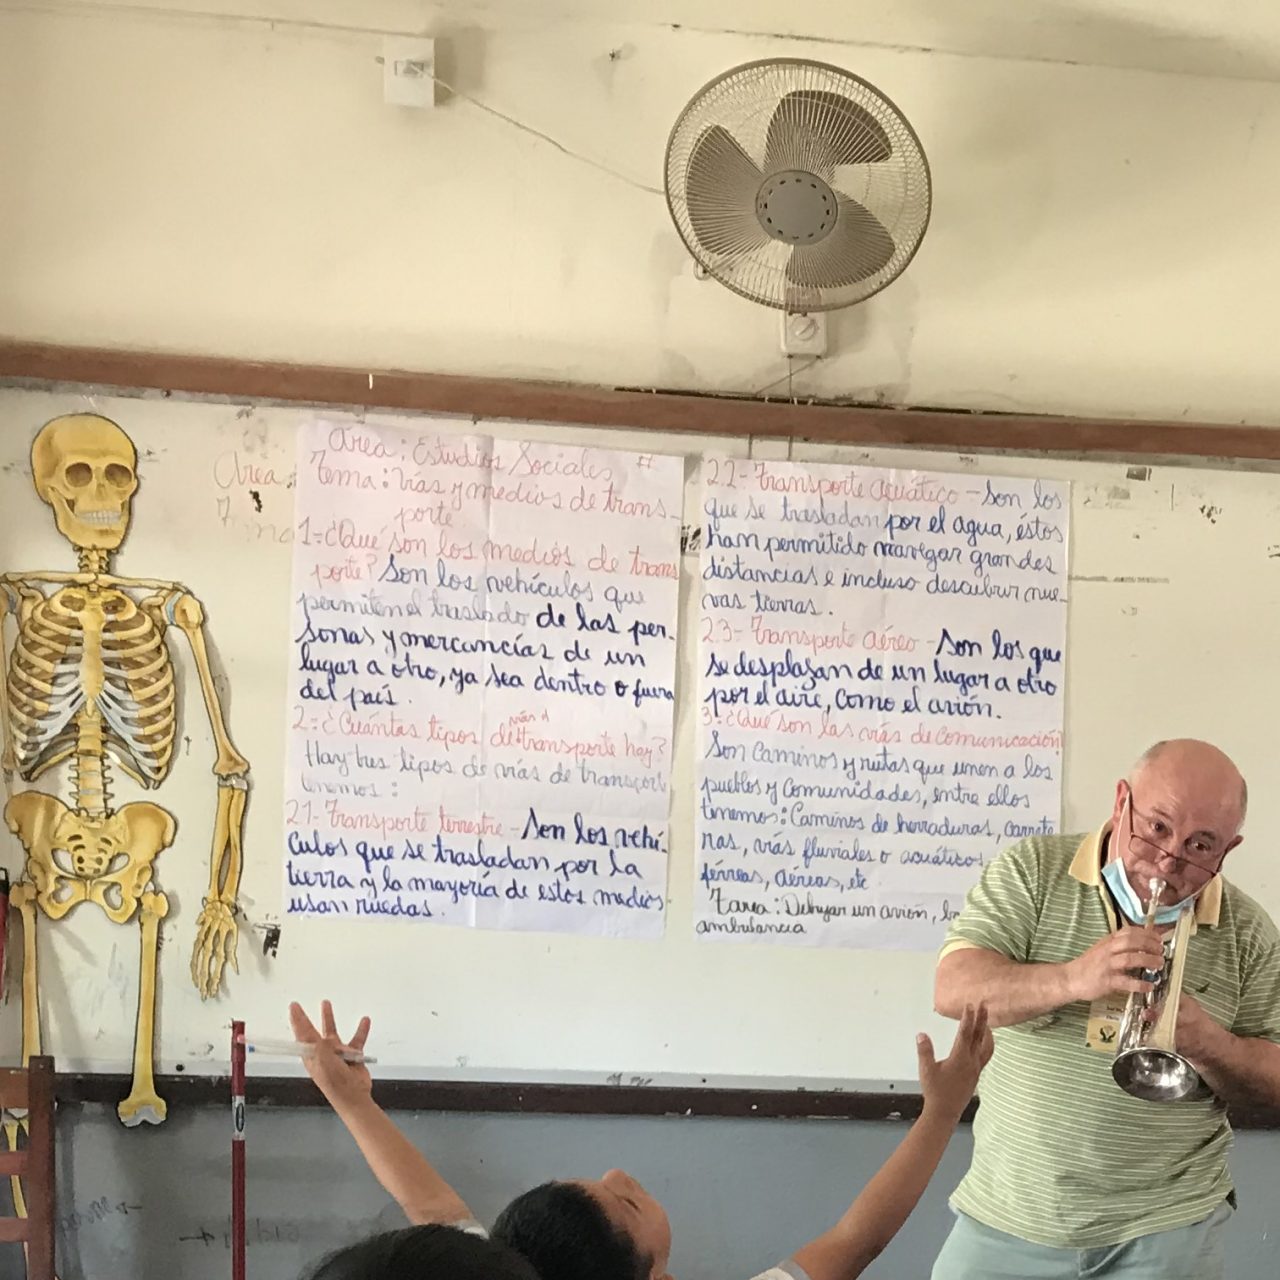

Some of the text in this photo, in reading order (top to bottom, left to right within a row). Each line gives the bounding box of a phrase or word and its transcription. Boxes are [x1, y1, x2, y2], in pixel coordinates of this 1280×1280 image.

[509, 441, 614, 482] Sociales
[451, 482, 464, 511] y
[466, 481, 562, 511] medios
[570, 484, 598, 513] de
[754, 462, 1062, 509] Transporte acuático los
[395, 501, 453, 533] porte
[704, 497, 738, 531] que
[744, 496, 766, 521] se
[780, 496, 880, 528] trasladan
[884, 513, 921, 540] por
[927, 505, 946, 535] el
[1015, 512, 1064, 543] éstos
[438, 523, 477, 560] los
[483, 537, 575, 568] medios
[588, 544, 619, 574] de
[706, 523, 760, 551] han
[763, 530, 868, 562] permitido
[969, 548, 1058, 578] grandes
[437, 558, 477, 593] los
[486, 567, 594, 602] vehículos
[604, 586, 646, 614] que
[702, 554, 1020, 599] distancias e incluso descubrir
[536, 602, 566, 629] de
[575, 602, 621, 635] las
[702, 593, 747, 611] vas
[382, 629, 398, 659] y
[401, 632, 554, 661] mercancías
[563, 640, 592, 663] de
[604, 649, 646, 669] un
[751, 615, 1062, 675] Transporte aéreo los que
[299, 641, 360, 684] lugar
[366, 658, 385, 676] a
[449, 667, 479, 695] ya
[484, 662, 525, 689] sea
[533, 665, 607, 697] dentro
[615, 680, 629, 698] o
[632, 678, 675, 707] fuera
[299, 678, 338, 702] del
[705, 652, 729, 678] se
[857, 657, 884, 680] de
[892, 664, 926, 682] un
[934, 658, 989, 697] lugar
[995, 675, 1011, 693] a
[1017, 666, 1057, 697] otro
[704, 685, 749, 718] por
[755, 680, 771, 707] el
[902, 685, 922, 714] el
[427, 714, 481, 752] tipos
[490, 721, 513, 748] de
[818, 709, 854, 740] las
[859, 722, 901, 744] vías
[910, 723, 931, 745] de
[304, 739, 350, 777] Hay
[352, 743, 391, 770] tres
[394, 746, 457, 784] tipos
[462, 754, 488, 779] de
[549, 761, 572, 785] de
[843, 756, 857, 781] y
[860, 746, 910, 774] rutas
[913, 759, 945, 785] que
[952, 761, 999, 777] unen
[1004, 764, 1016, 780] a
[1023, 753, 1054, 782] los
[700, 770, 1030, 809] pueblos y entre ellos
[325, 799, 428, 841] Transporte
[574, 811, 609, 847] los
[872, 812, 888, 834] de
[355, 834, 644, 882] que se trasladan por la
[754, 831, 795, 856] vías
[802, 836, 876, 869] fluviales
[880, 850, 892, 864] o
[286, 860, 587, 905] tierra y la mayoría de estos
[287, 894, 349, 914] usan
[851, 905, 876, 918] un
[696, 917, 807, 935] ambulancia
